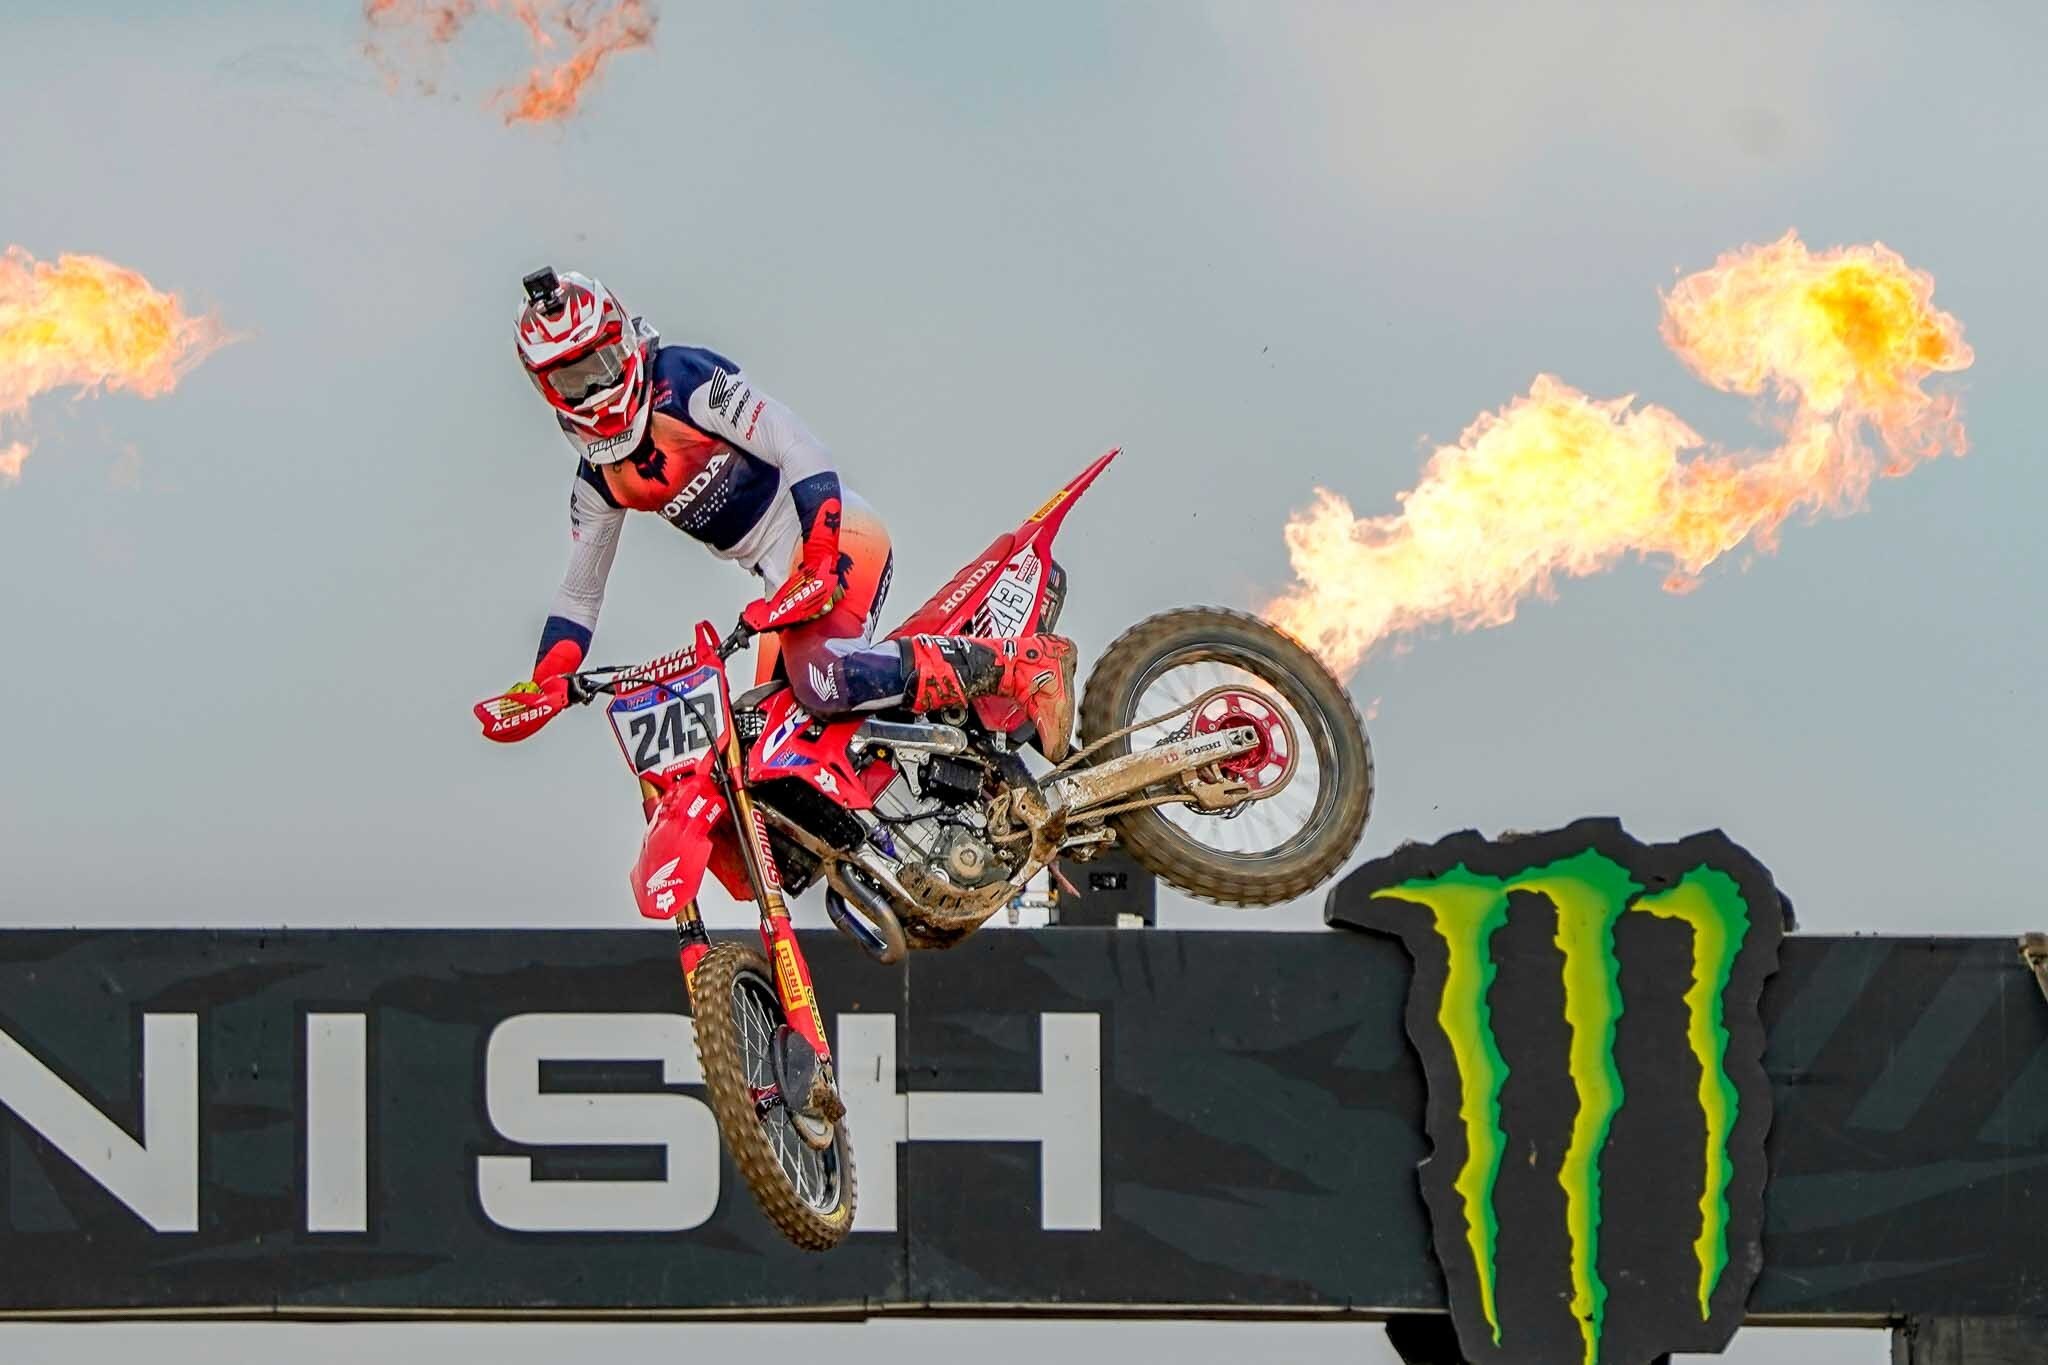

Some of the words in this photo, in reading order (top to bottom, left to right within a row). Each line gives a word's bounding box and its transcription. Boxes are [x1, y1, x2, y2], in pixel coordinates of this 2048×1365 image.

[768, 579, 824, 623] ACERBIS
[939, 560, 999, 614] HONDA
[491, 705, 553, 732] ACERBIS
[629, 693, 718, 773] 243
[1184, 740, 1221, 756] GOSHI
[646, 878, 685, 897] HONDA
[776, 947, 803, 1003] PIRELLI
[0, 1012, 1101, 1233] NISH
